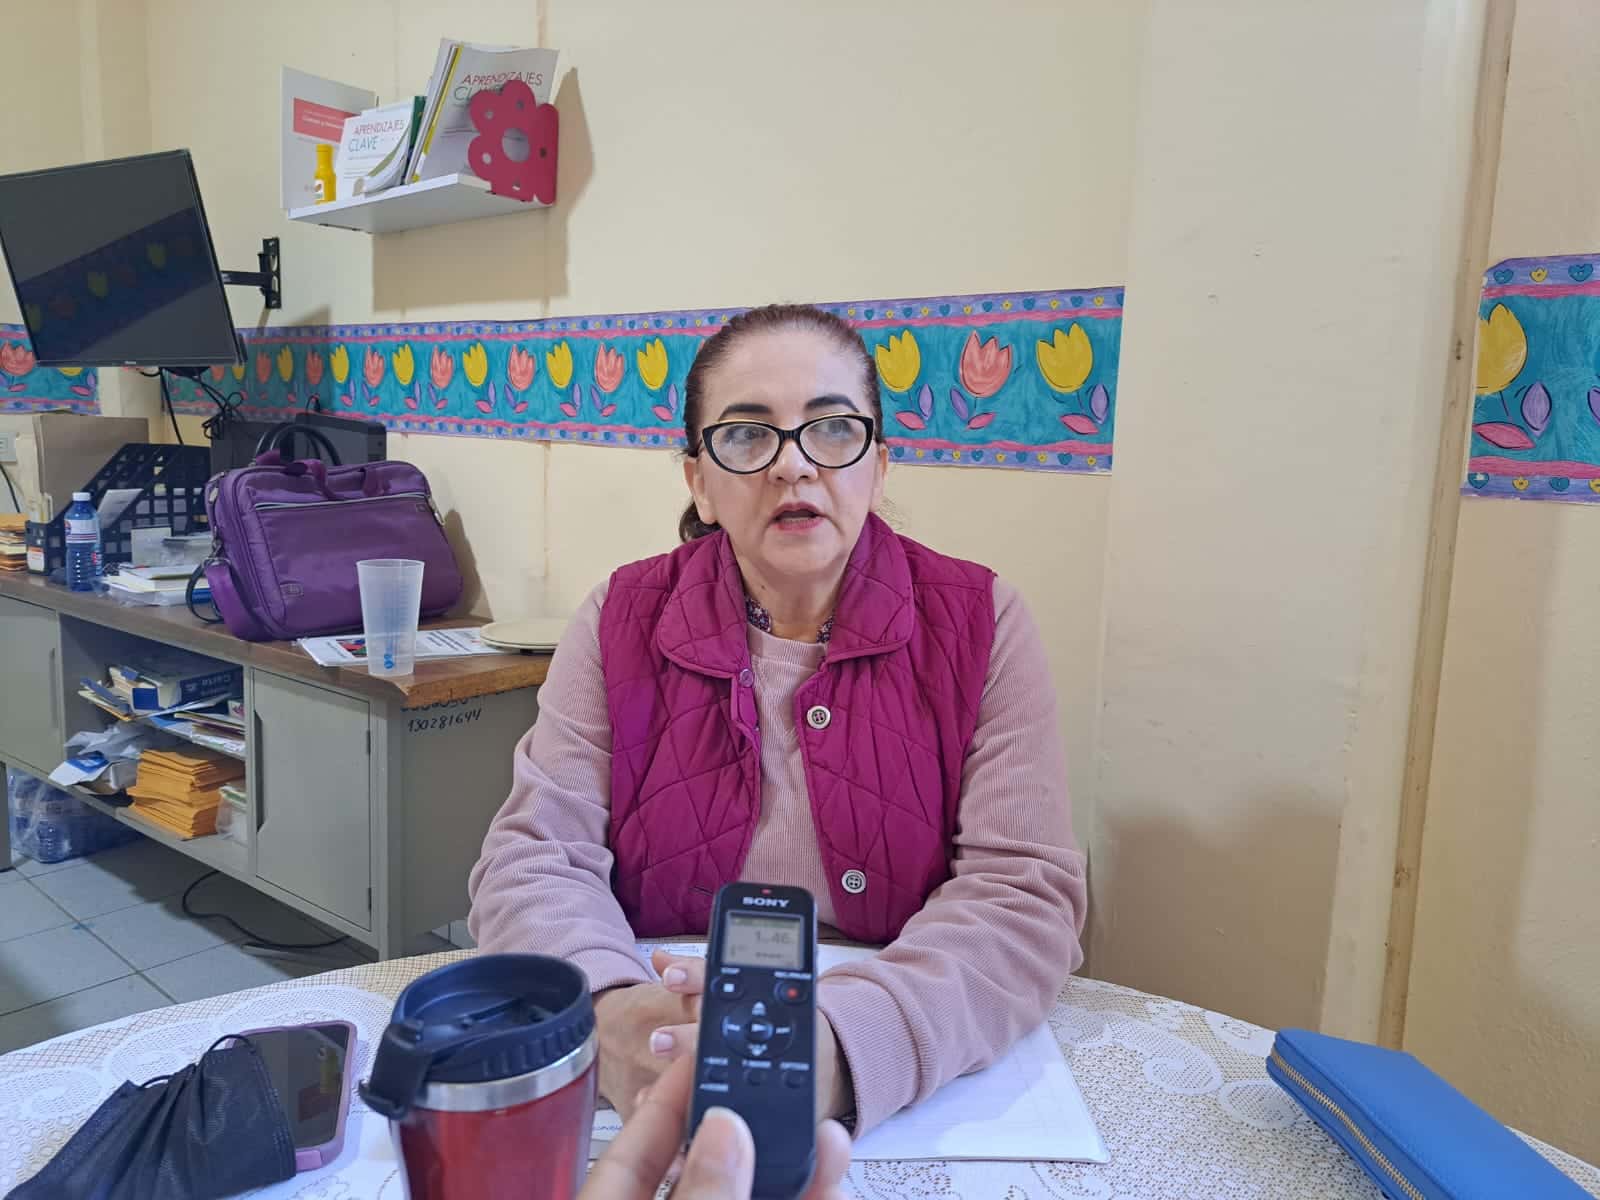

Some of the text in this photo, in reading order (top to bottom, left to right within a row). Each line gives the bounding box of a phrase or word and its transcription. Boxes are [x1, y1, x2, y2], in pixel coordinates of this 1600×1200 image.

[352, 119, 404, 135] APRENDIZAJES
[348, 135, 378, 153] CLAVE
[408, 708, 482, 733] 130281644
[742, 896, 790, 909] SONY
